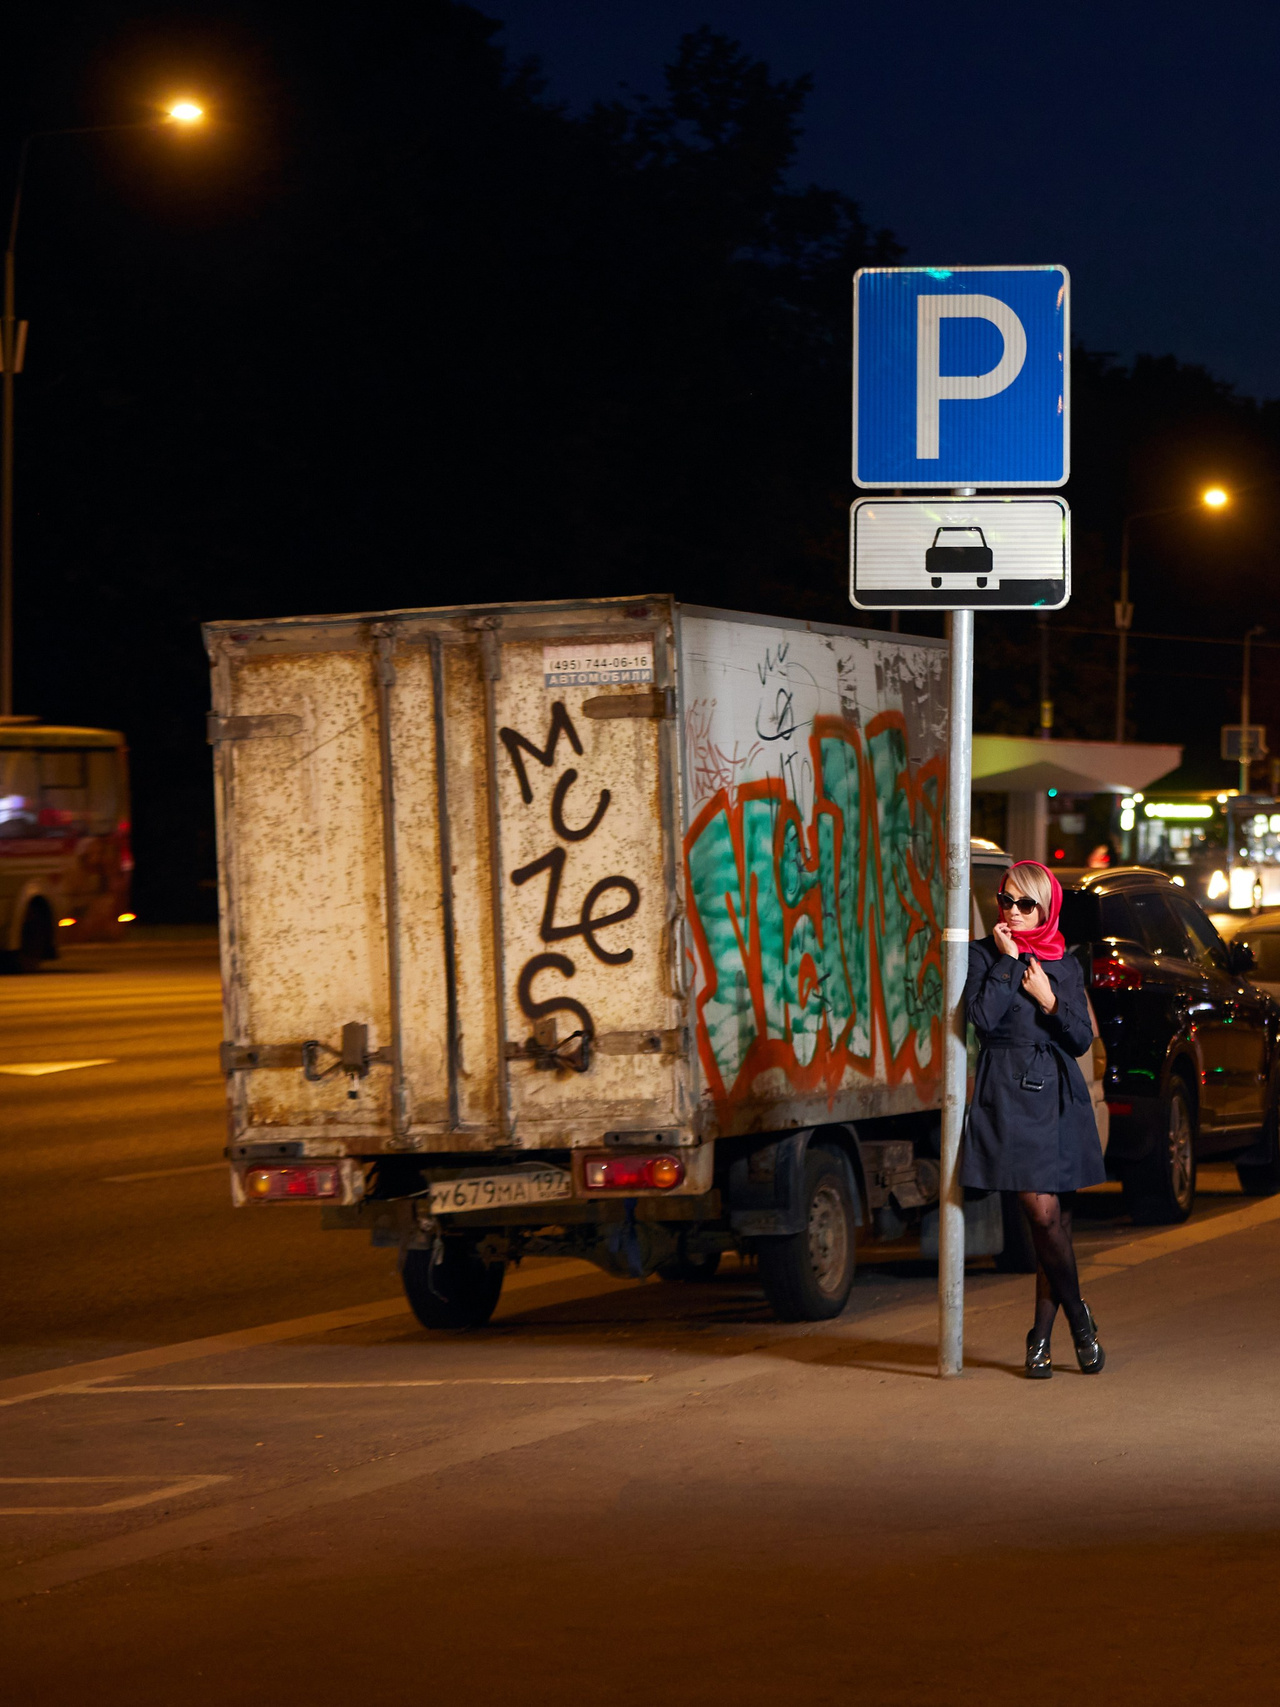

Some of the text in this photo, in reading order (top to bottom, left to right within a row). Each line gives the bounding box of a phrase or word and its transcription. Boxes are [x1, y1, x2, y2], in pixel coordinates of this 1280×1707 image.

[916, 294, 1027, 460] P
[549, 656, 647, 671] (495) 744-06-16
[549, 671, 650, 684] АВТОМОБИЛИ
[533, 1171, 565, 1191] 197
